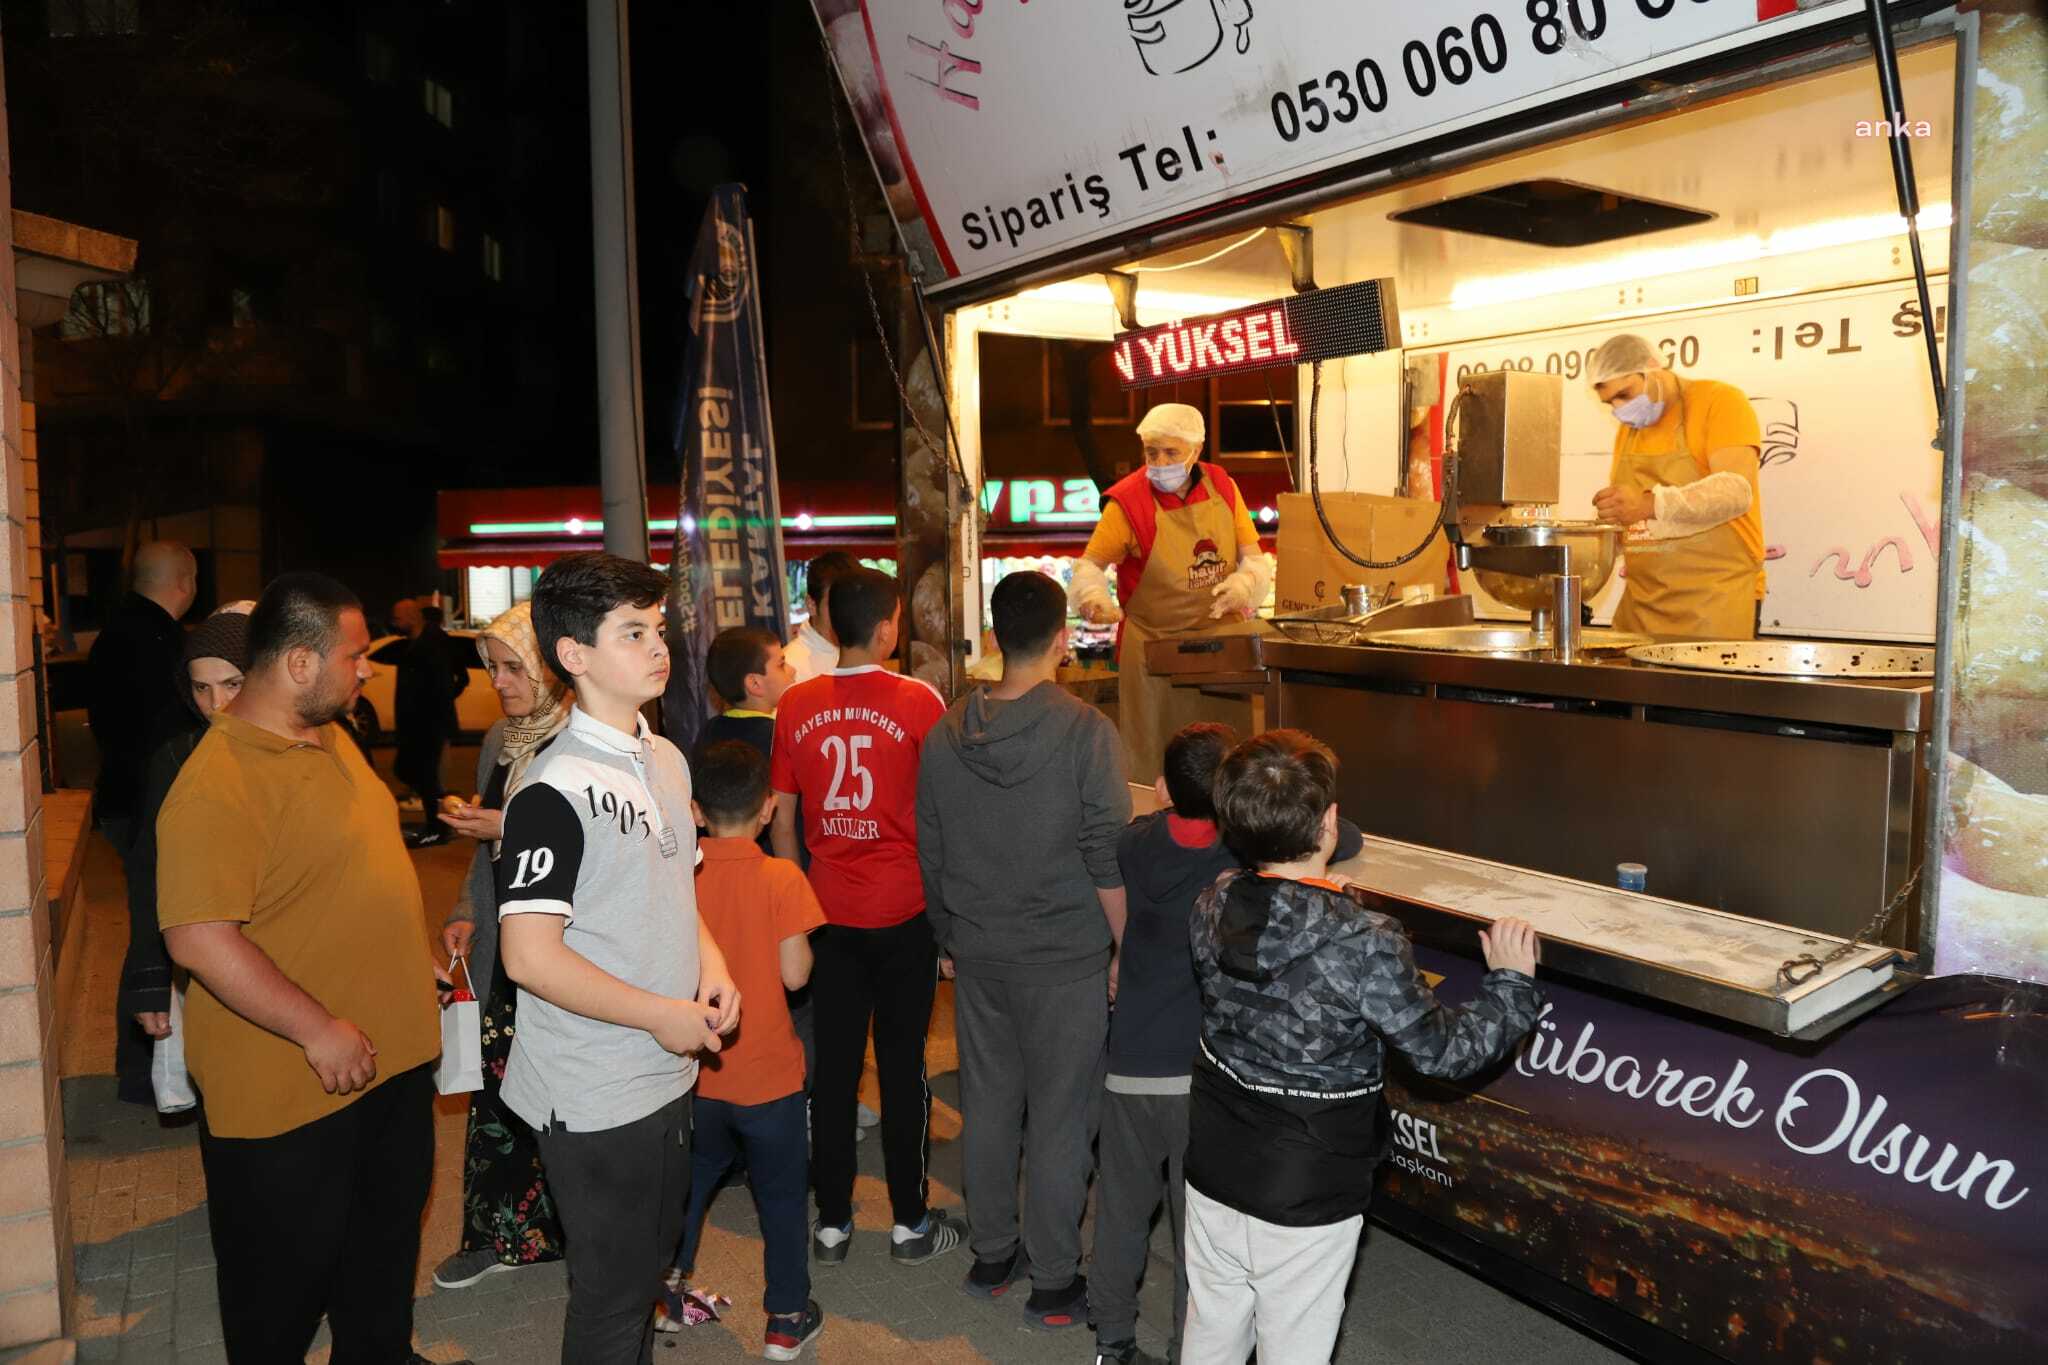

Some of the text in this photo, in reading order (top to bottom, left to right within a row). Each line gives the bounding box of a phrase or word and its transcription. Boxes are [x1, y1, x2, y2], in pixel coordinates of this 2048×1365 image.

[962, 173, 1111, 250] Sipariş
[1119, 126, 1226, 192] Tel:
[1271, 57, 1388, 142] 0530
[1402, 13, 1508, 97] 060
[1139, 311, 1298, 376] YÜKSEL
[1752, 317, 1862, 360] Tel:
[794, 709, 841, 744] BAYERN
[820, 735, 873, 811] 25
[508, 847, 555, 889] 19
[1773, 1068, 2030, 1211] Olsun
[1391, 1150, 1452, 1188] aşkanı
